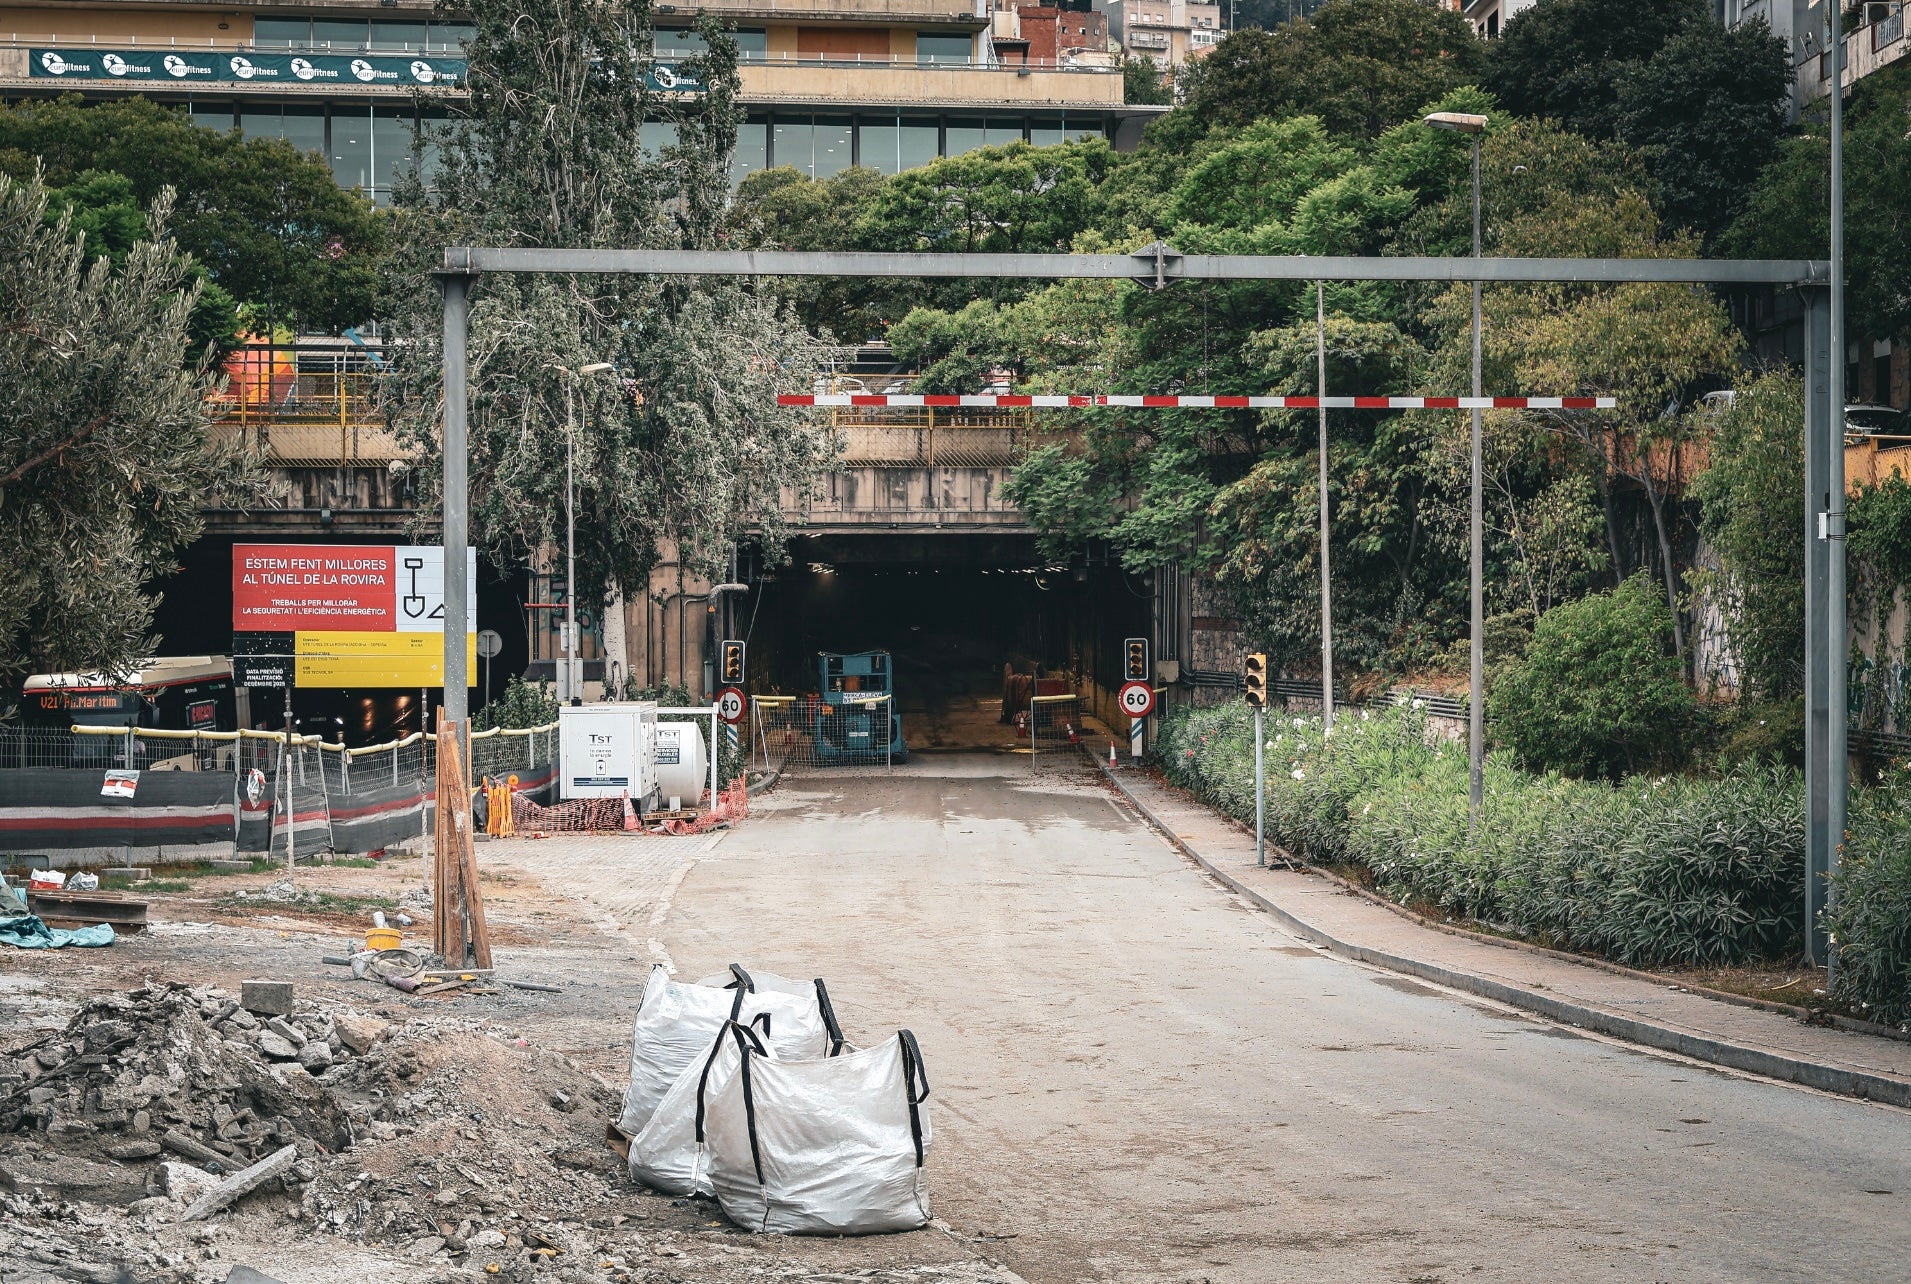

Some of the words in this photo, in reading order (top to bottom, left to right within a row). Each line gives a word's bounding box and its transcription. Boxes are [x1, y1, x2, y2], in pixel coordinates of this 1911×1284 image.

[245, 558, 288, 570] ESTEM
[291, 559, 322, 570] FENT
[326, 559, 387, 571] MILLORES
[243, 574, 258, 584] AL
[261, 571, 301, 585] TÚNEL
[304, 574, 320, 585] DE
[323, 575, 338, 585] LA
[341, 575, 385, 586] ROVIRA
[40, 696, 58, 709] V21
[1127, 694, 1146, 705] 60
[722, 700, 739, 712] 60
[589, 734, 613, 744] TST
